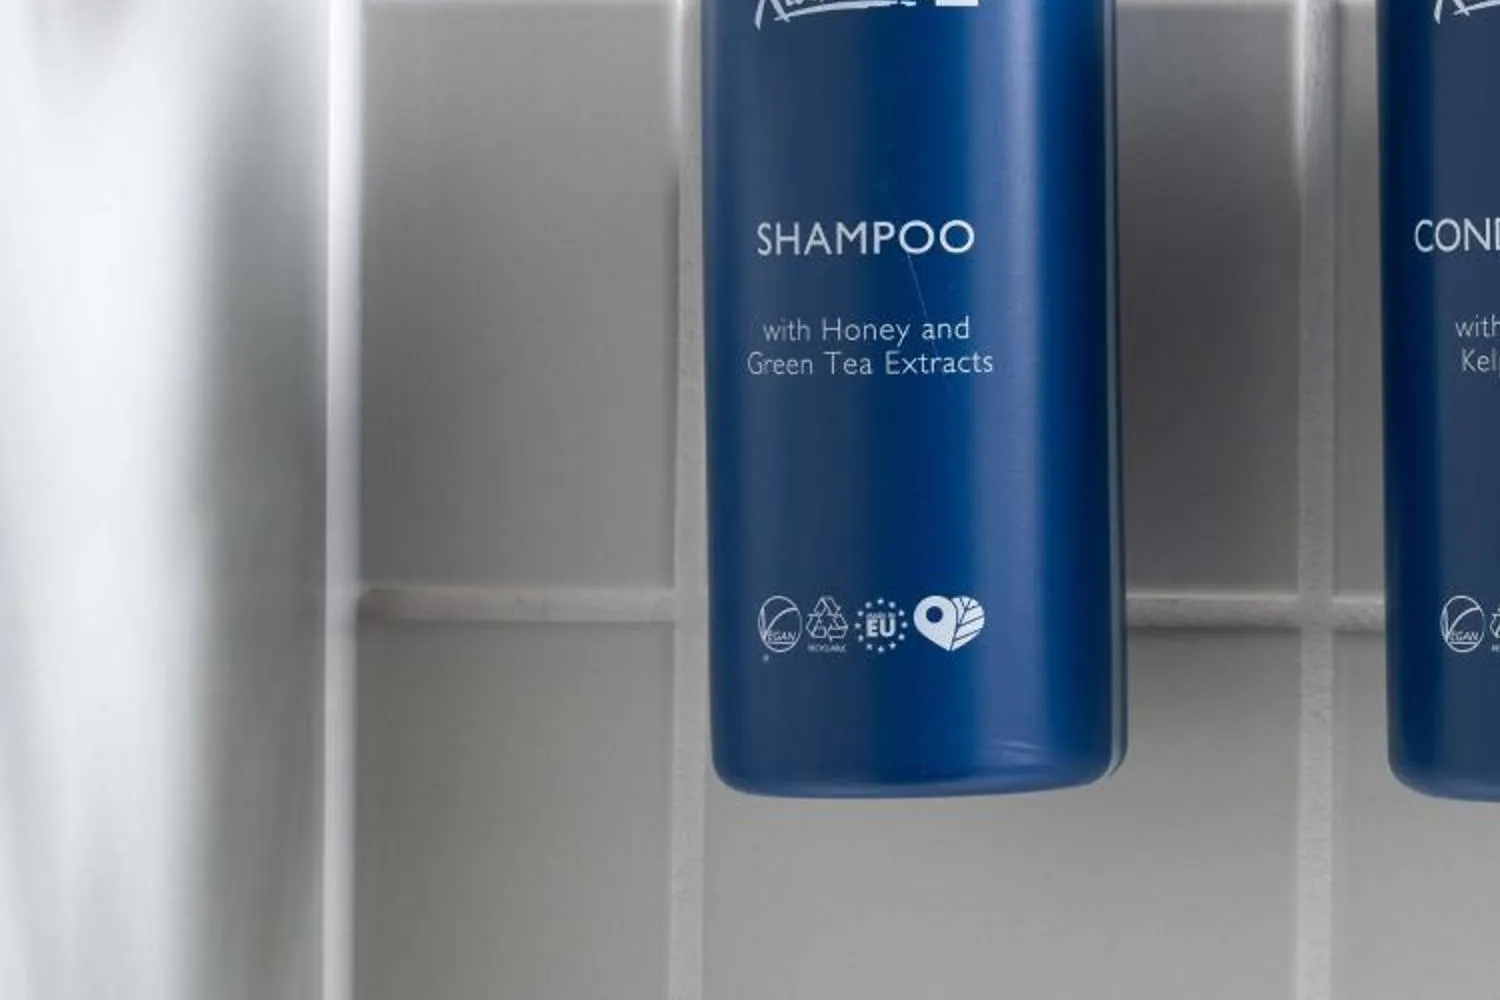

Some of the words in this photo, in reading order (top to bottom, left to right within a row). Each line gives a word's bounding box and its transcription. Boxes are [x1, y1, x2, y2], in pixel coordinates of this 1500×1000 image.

[758, 220, 974, 256] SHAMPOO
[763, 318, 810, 341] with
[822, 317, 910, 347] Honey
[921, 316, 969, 340] and
[747, 351, 813, 375] Green
[824, 351, 873, 375] Tea
[886, 350, 992, 374] Extracts
[866, 618, 896, 638] EU
